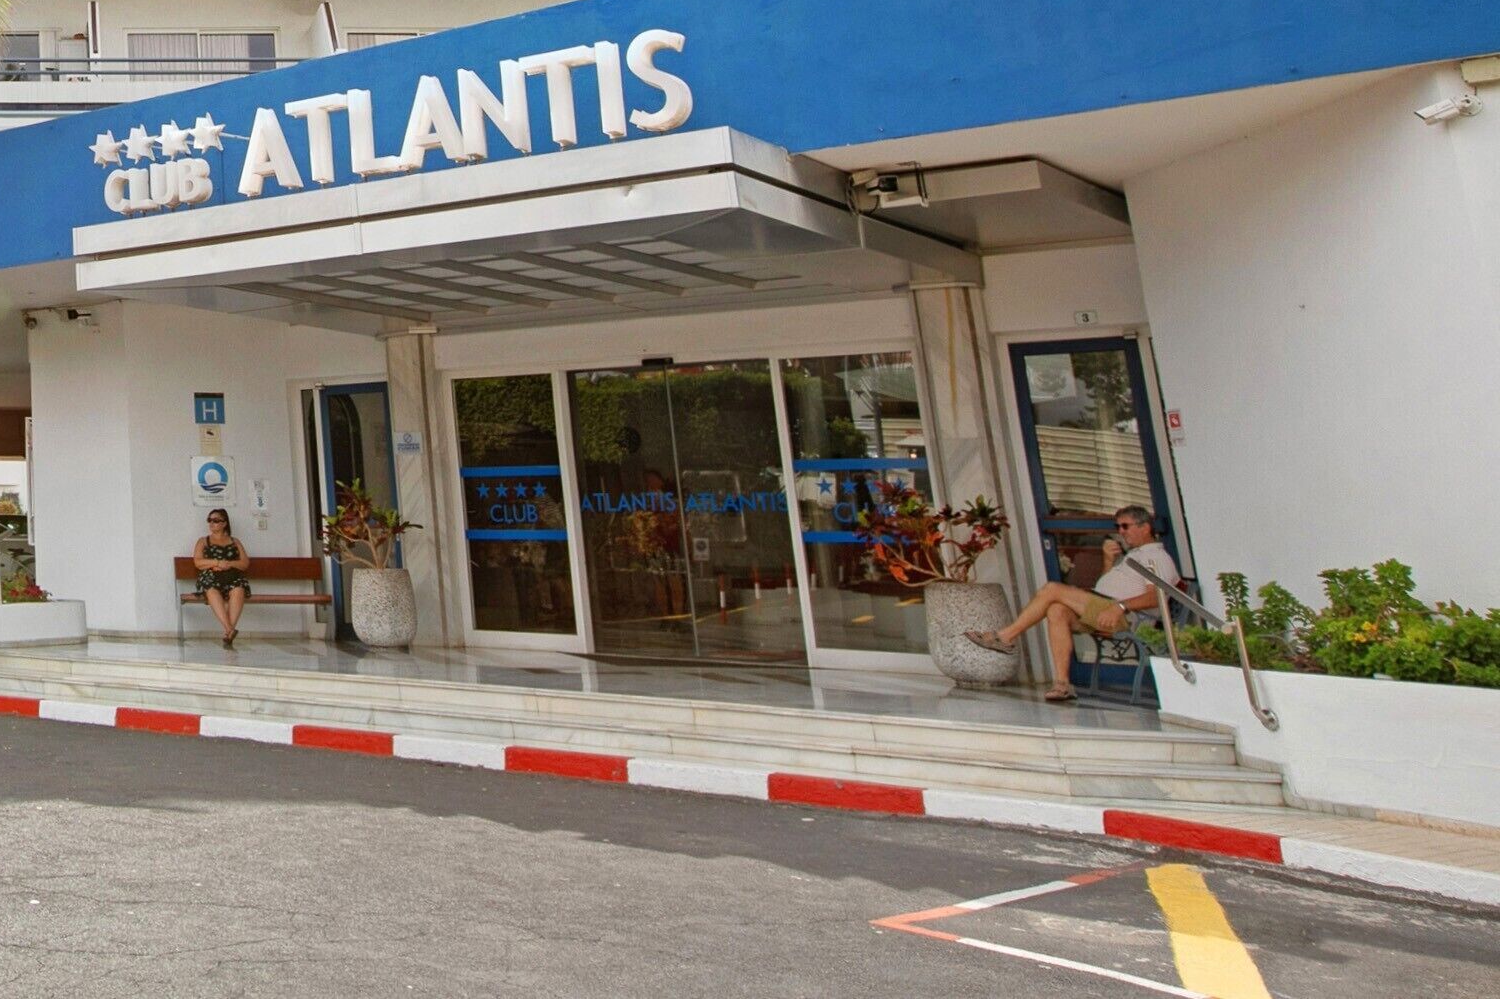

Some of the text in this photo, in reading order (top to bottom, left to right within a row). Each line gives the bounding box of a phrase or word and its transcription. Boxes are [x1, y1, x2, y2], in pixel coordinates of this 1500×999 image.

[238, 29, 693, 196] ATLANTIS
[104, 158, 213, 214] CLUB
[1082, 313, 1090, 323] 3
[489, 503, 539, 525] CLUB
[581, 491, 676, 513] ATLANTIS
[685, 491, 789, 513] ATLANTIS
